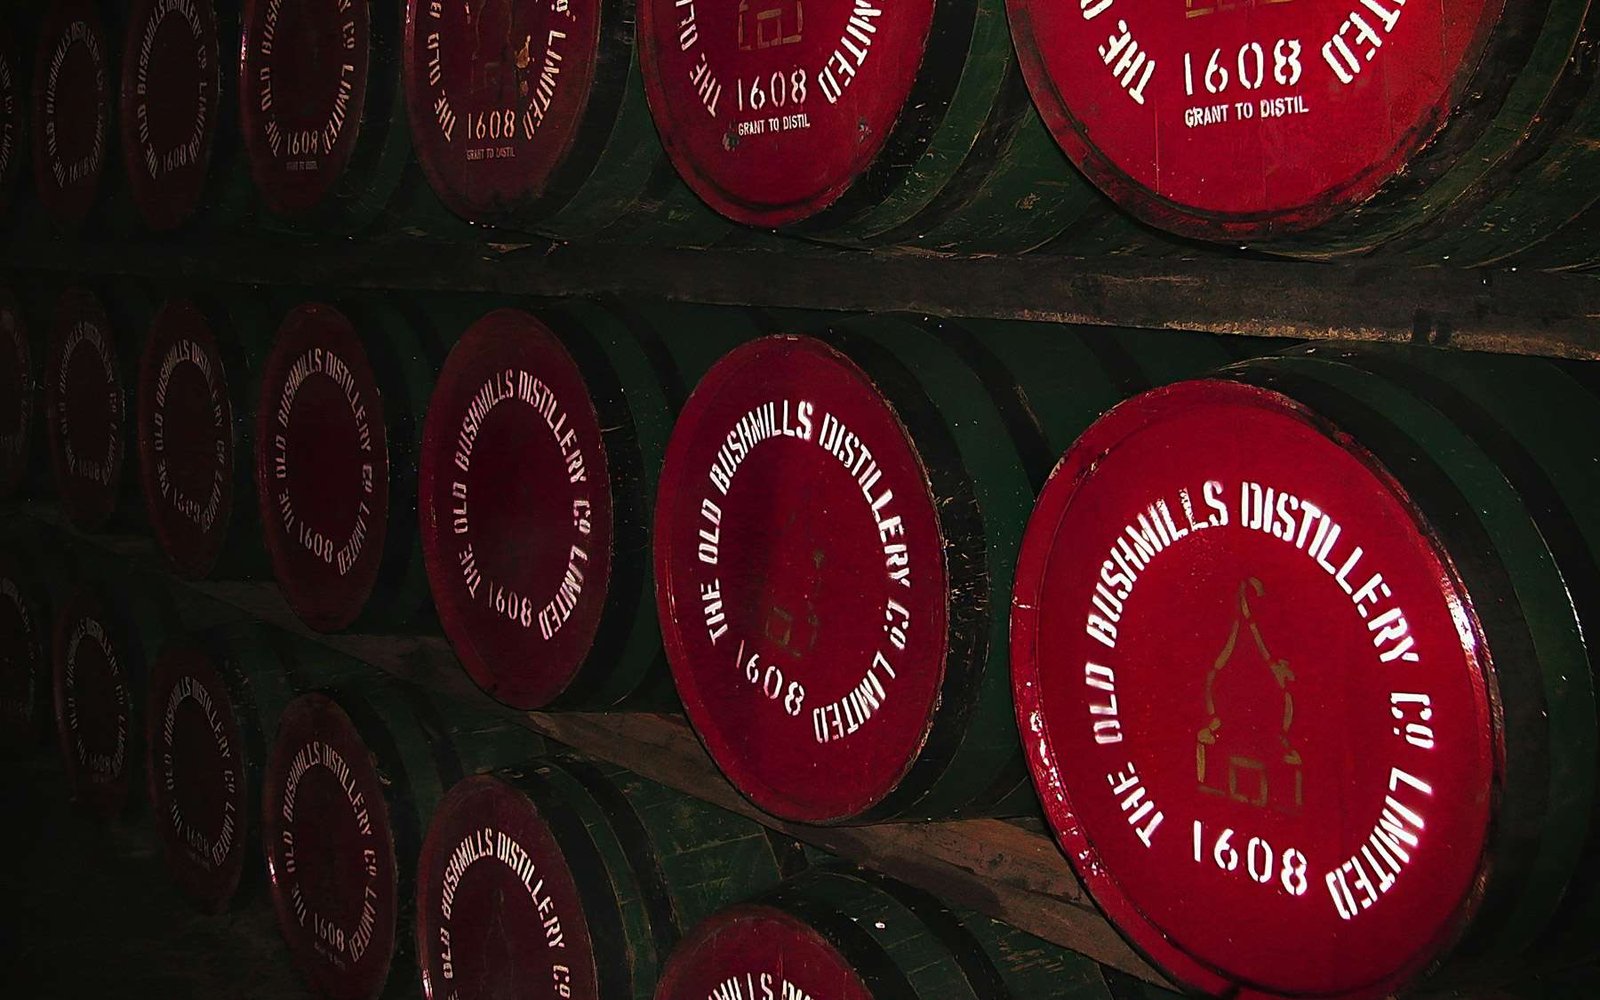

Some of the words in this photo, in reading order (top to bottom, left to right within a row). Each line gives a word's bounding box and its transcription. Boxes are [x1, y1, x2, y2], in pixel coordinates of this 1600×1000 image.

[426, 32, 441, 86] OLD
[522, 30, 567, 140] LIMITED
[690, 52, 722, 118] THE
[817, 0, 883, 104] MITED
[737, 65, 807, 111] 1608
[1098, 19, 1156, 105] THE
[1184, 38, 1302, 96] 1608
[288, 130, 319, 156] 1608
[322, 64, 354, 155] LIMITED
[434, 88, 457, 143] THE
[466, 108, 516, 140] 1608
[738, 119, 765, 136] GRANT
[769, 117, 780, 132] TO
[783, 113, 811, 131] DISTIL
[1184, 101, 1228, 127] GRANT
[1235, 101, 1253, 120] TO
[1260, 95, 1310, 119] DISTIL
[278, 348, 322, 429] BUSHMILLS
[325, 350, 372, 452] DISTILLERY
[454, 368, 514, 472] BUSHMILLS
[518, 370, 587, 484] DISTILLERY
[275, 434, 287, 479] OLD
[709, 399, 814, 496] BUSHMILLS
[279, 488, 295, 534] THE
[337, 500, 371, 576] LIMITED
[452, 481, 469, 534] OLD
[699, 498, 722, 565] OLD
[819, 412, 911, 588] DISTILLERY
[299, 521, 334, 564] 1608
[458, 542, 482, 600] THE
[1086, 480, 1229, 648] BUSHMILLS
[1240, 481, 1420, 664] DISTILLERY
[488, 580, 533, 628] 1608
[537, 544, 589, 640] LIMITED
[701, 577, 729, 646] THE
[736, 639, 806, 717] 1608
[812, 650, 897, 744] LIMITED
[1085, 662, 1123, 745] OLD
[282, 740, 321, 823] BUSHMILLS
[322, 744, 372, 836] DISTILLERY
[1107, 761, 1165, 848] THE
[282, 830, 297, 874] OLD
[441, 827, 493, 920] BUSHMILLS
[1191, 819, 1309, 896] 1608
[1325, 766, 1433, 921] LIMITED
[349, 886, 377, 963] LIMITED
[497, 831, 566, 948] DISTILLERY
[314, 912, 345, 952] 1608
[439, 927, 454, 980] OLD
